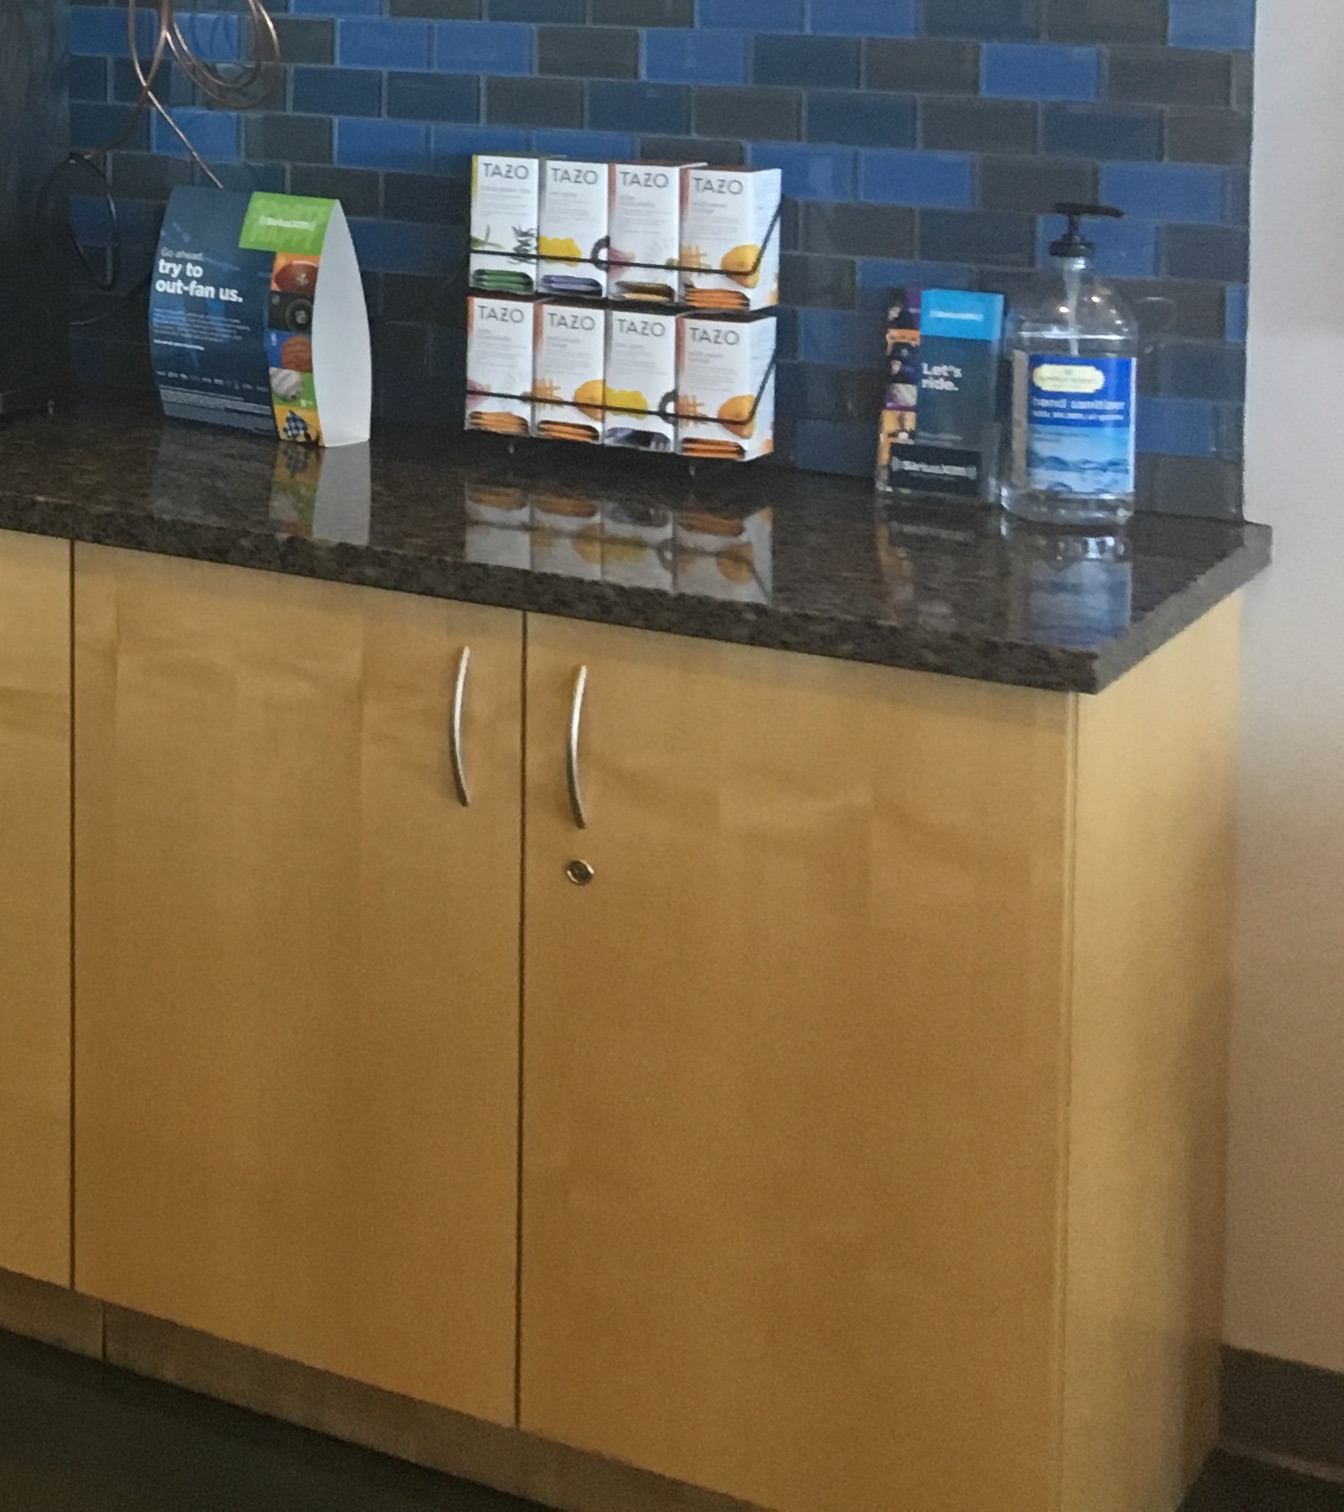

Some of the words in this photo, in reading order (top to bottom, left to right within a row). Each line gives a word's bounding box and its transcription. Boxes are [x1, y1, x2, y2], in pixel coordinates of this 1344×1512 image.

[482, 162, 530, 180] TAZO
[551, 167, 599, 185] TAZO
[620, 171, 669, 189] TAZO
[693, 177, 744, 195] TAZO
[158, 258, 183, 278] try
[185, 262, 203, 278] to
[155, 279, 216, 299] out-fan
[218, 287, 244, 303] us.
[478, 305, 525, 323] TAZO
[547, 312, 596, 331] TAZO
[616, 318, 666, 337] TAZO
[689, 326, 740, 346] TAZO
[921, 361, 962, 378] Let's
